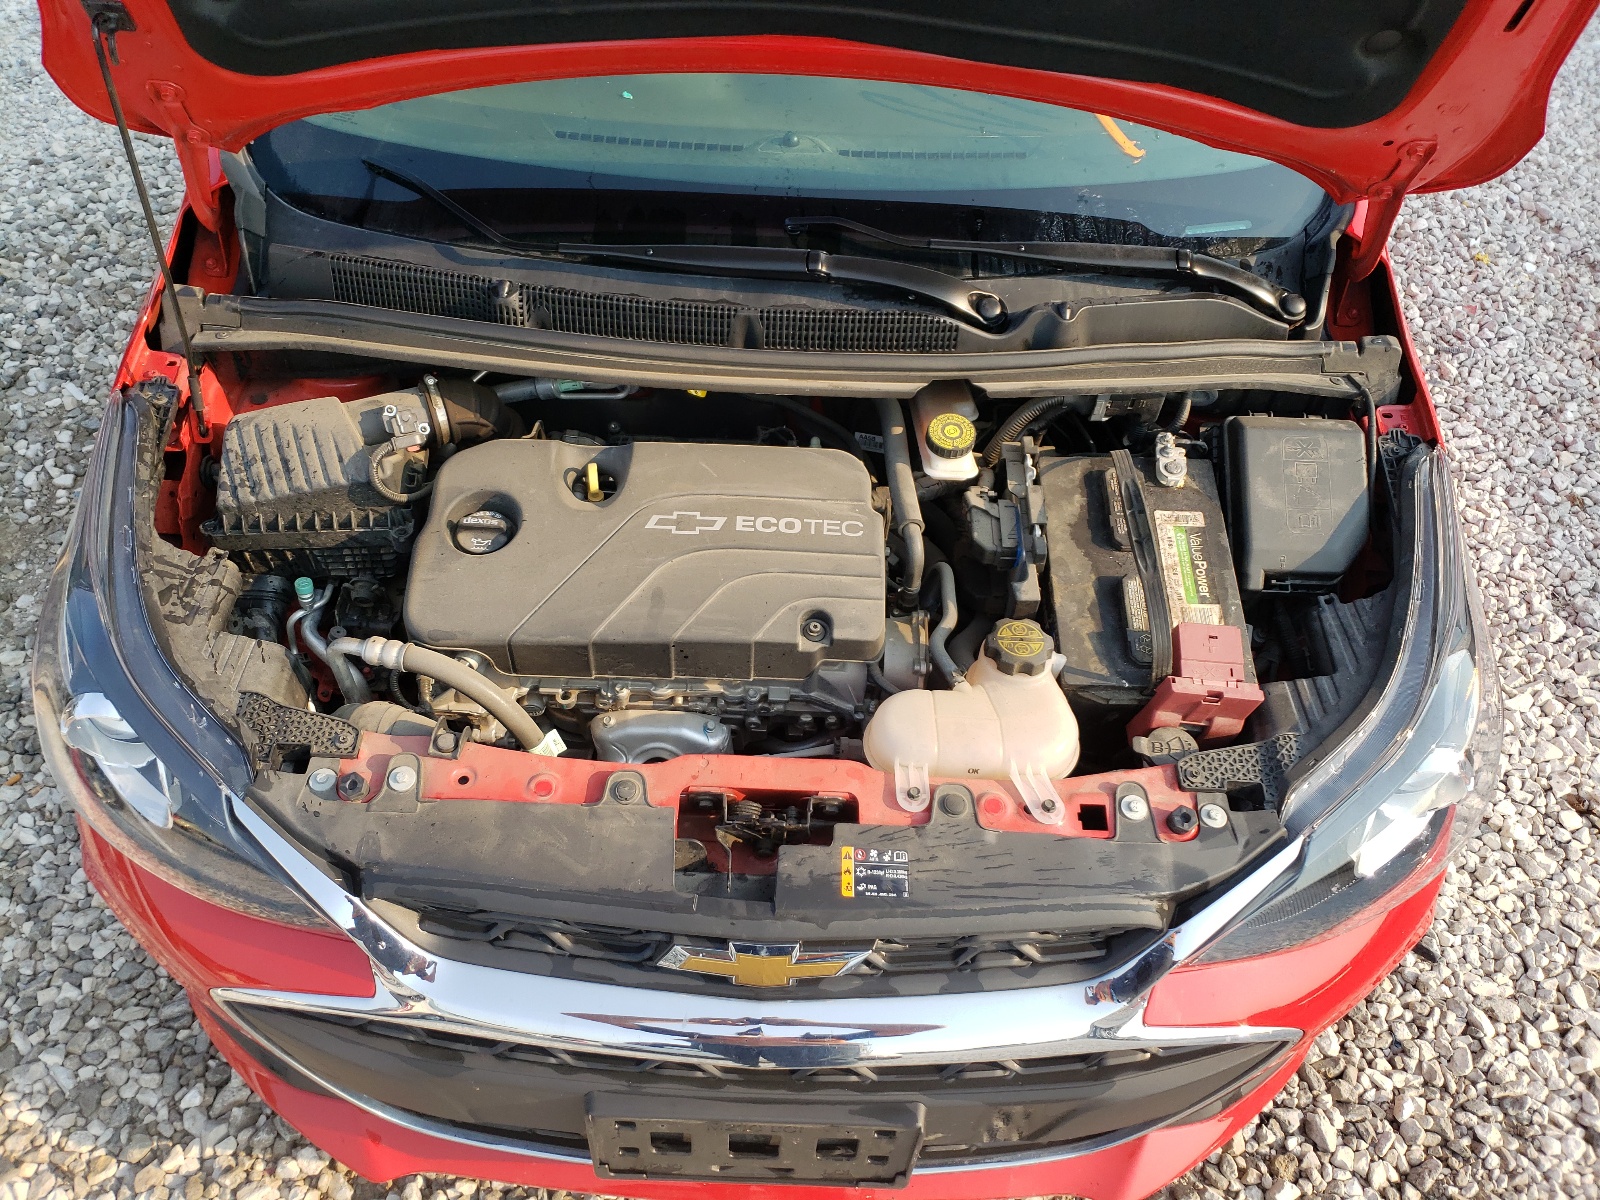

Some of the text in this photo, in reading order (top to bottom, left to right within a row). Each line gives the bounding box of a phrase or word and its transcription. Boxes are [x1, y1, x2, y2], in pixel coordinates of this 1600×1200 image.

[463, 516, 499, 526] dexos
[736, 515, 864, 537] ECOTEC
[1189, 532, 1211, 598] ValuePower
[967, 767, 980, 775] OK
